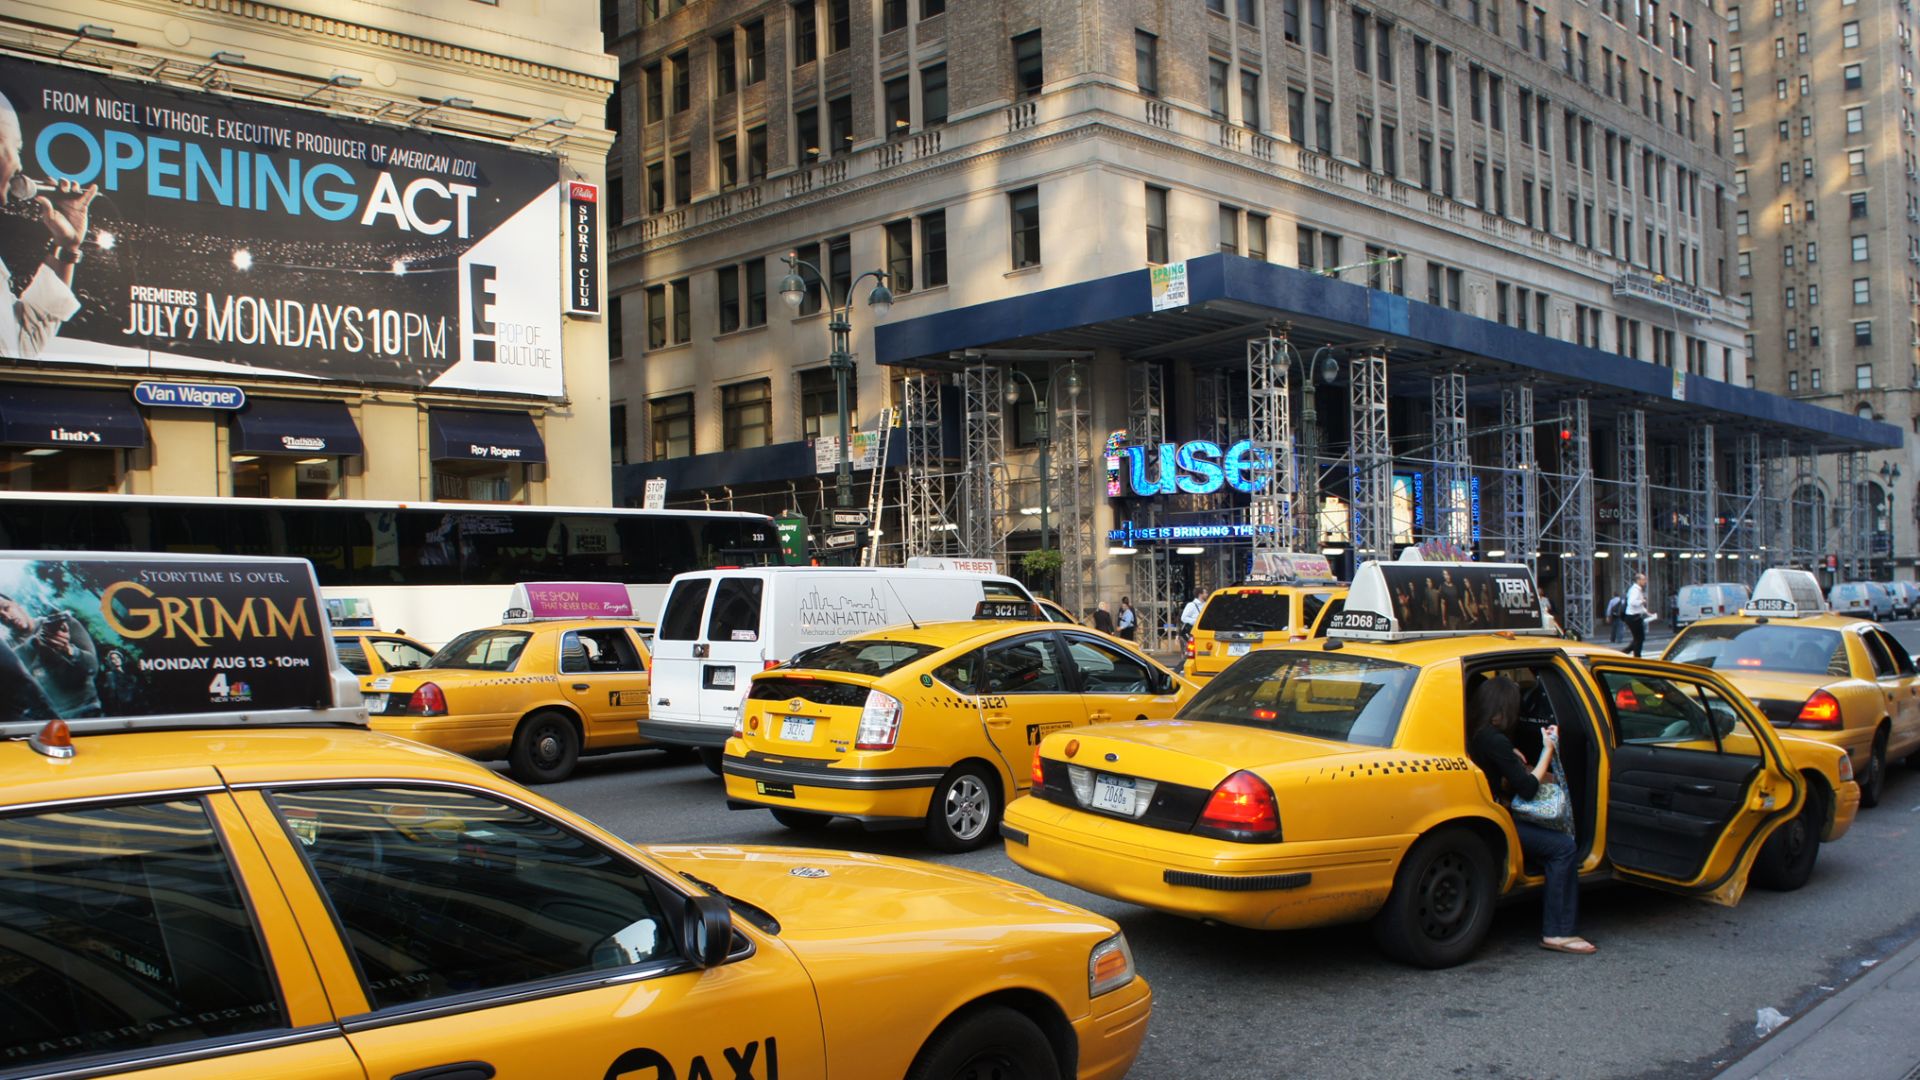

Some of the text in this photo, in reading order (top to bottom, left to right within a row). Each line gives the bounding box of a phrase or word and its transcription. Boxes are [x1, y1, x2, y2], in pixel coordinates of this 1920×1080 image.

[43, 89, 89, 116] FROM
[96, 97, 141, 124] NIGEL
[218, 119, 291, 148] EXECUTIVE
[296, 131, 367, 161] PRODUCER
[371, 144, 388, 163] OF
[388, 148, 450, 174] AMERICAN
[451, 158, 478, 179] IDOL
[35, 121, 477, 239] OPENING ACT
[577, 205, 589, 306] SPORTS CLUB
[130, 285, 198, 306] PREMIERES
[122, 303, 199, 339] JULY 9
[206, 293, 364, 353] MONDAYS
[498, 322, 542, 345] POP OF
[499, 344, 552, 369] CULTURE
[145, 386, 237, 407] Van Wagner
[51, 427, 101, 442] Lindy's
[470, 444, 521, 458] Roy Rogers
[1104, 429, 1273, 497] fuse
[647, 483, 665, 493] STOP
[752, 533, 765, 541] 333
[1128, 527, 1156, 539] FUSE
[1158, 527, 1171, 538] IS
[1173, 525, 1230, 538] BRINGING
[1232, 525, 1253, 536] THE
[953, 561, 993, 571] THE BEST
[140, 570, 290, 583] STORYTIME IS OVER.
[1496, 579, 1531, 594] TEEN
[530, 591, 579, 601] THE SHOW
[1499, 593, 1535, 608] WOLF
[541, 601, 558, 609] THAT
[559, 602, 579, 610] NEVER
[995, 605, 1017, 616] 3C21
[102, 581, 316, 647] GRIMM
[803, 611, 887, 625] MANHATTAN
[1345, 614, 1373, 627] 2D68
[802, 628, 836, 636] Mechanical
[140, 656, 310, 671] MONDAY AUG 13 10PM
[209, 673, 230, 696] 4
[979, 696, 1008, 709] 3C21
[1432, 757, 1468, 771] 2D68
